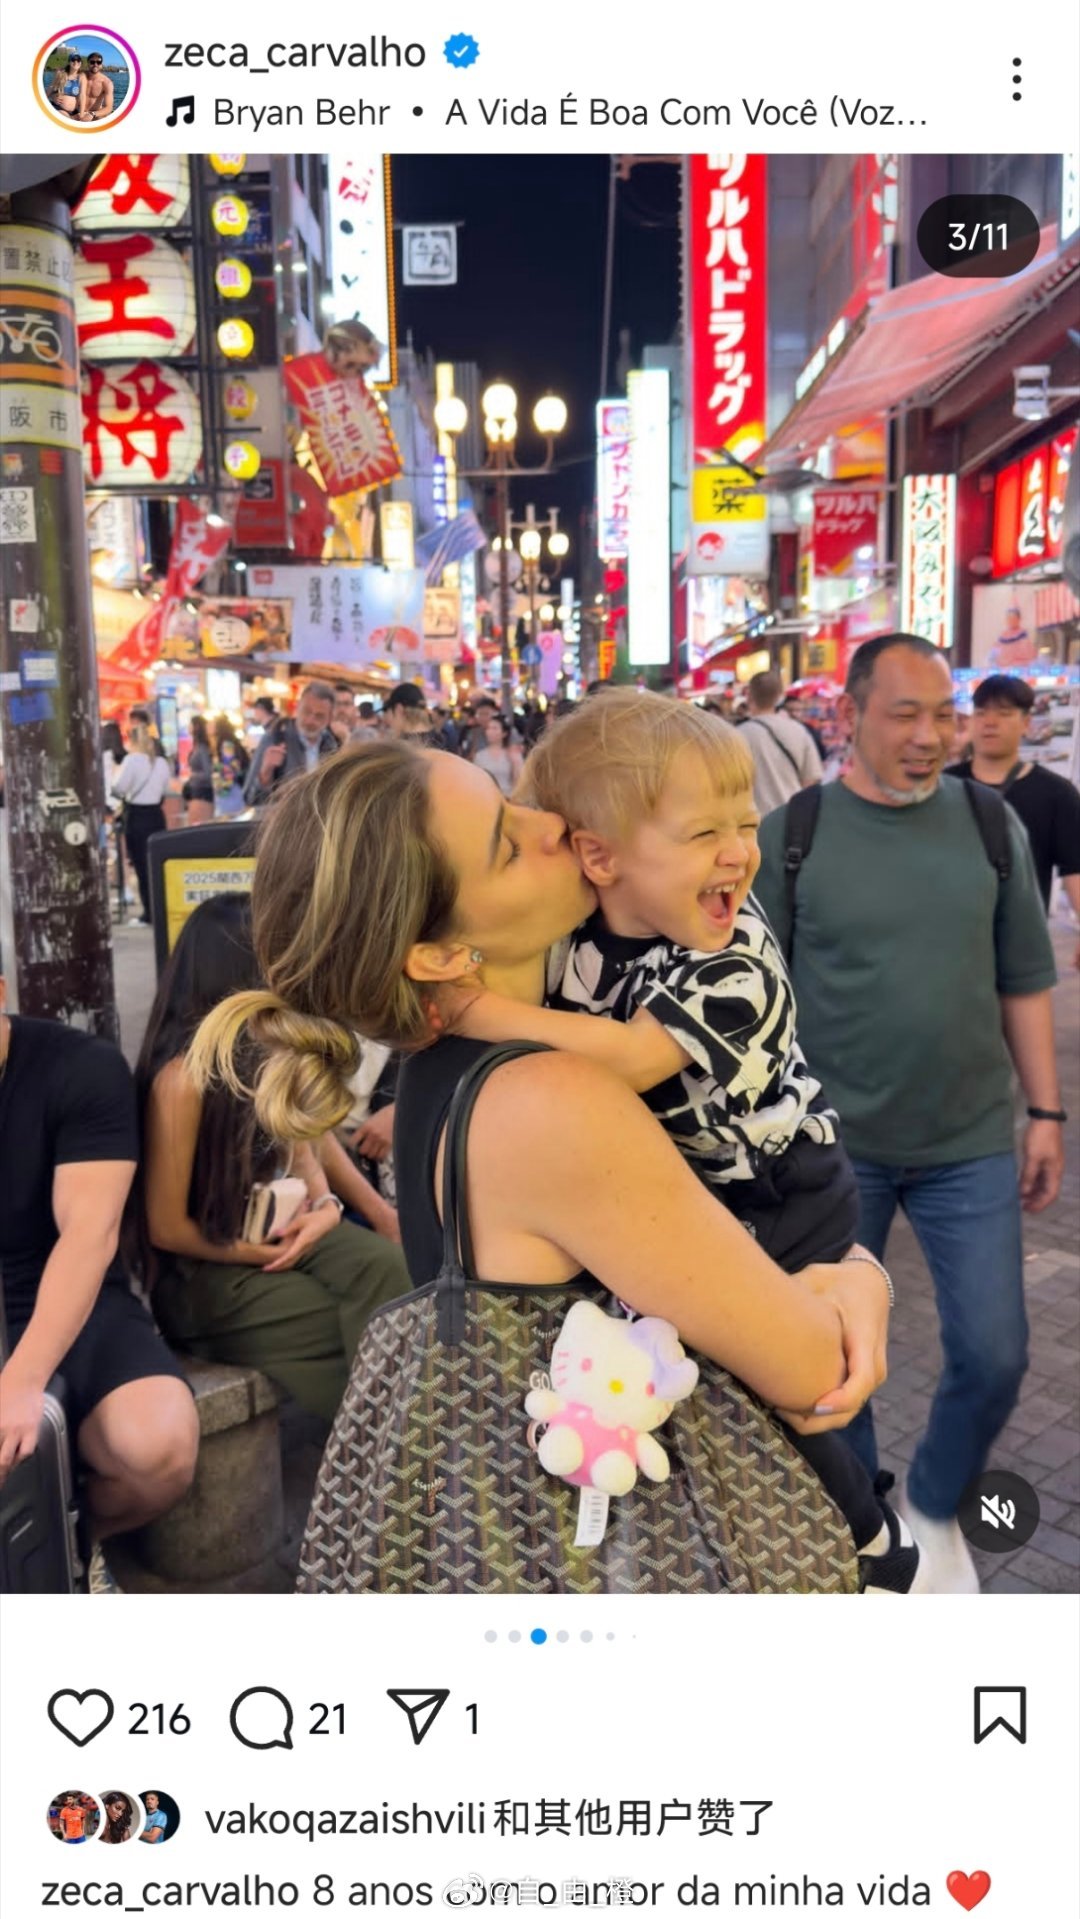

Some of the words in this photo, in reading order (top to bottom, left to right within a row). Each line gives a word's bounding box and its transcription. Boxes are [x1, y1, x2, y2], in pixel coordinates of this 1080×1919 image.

[705, 153, 754, 426] ツルハドラッグ
[814, 494, 876, 516] ツルハ
